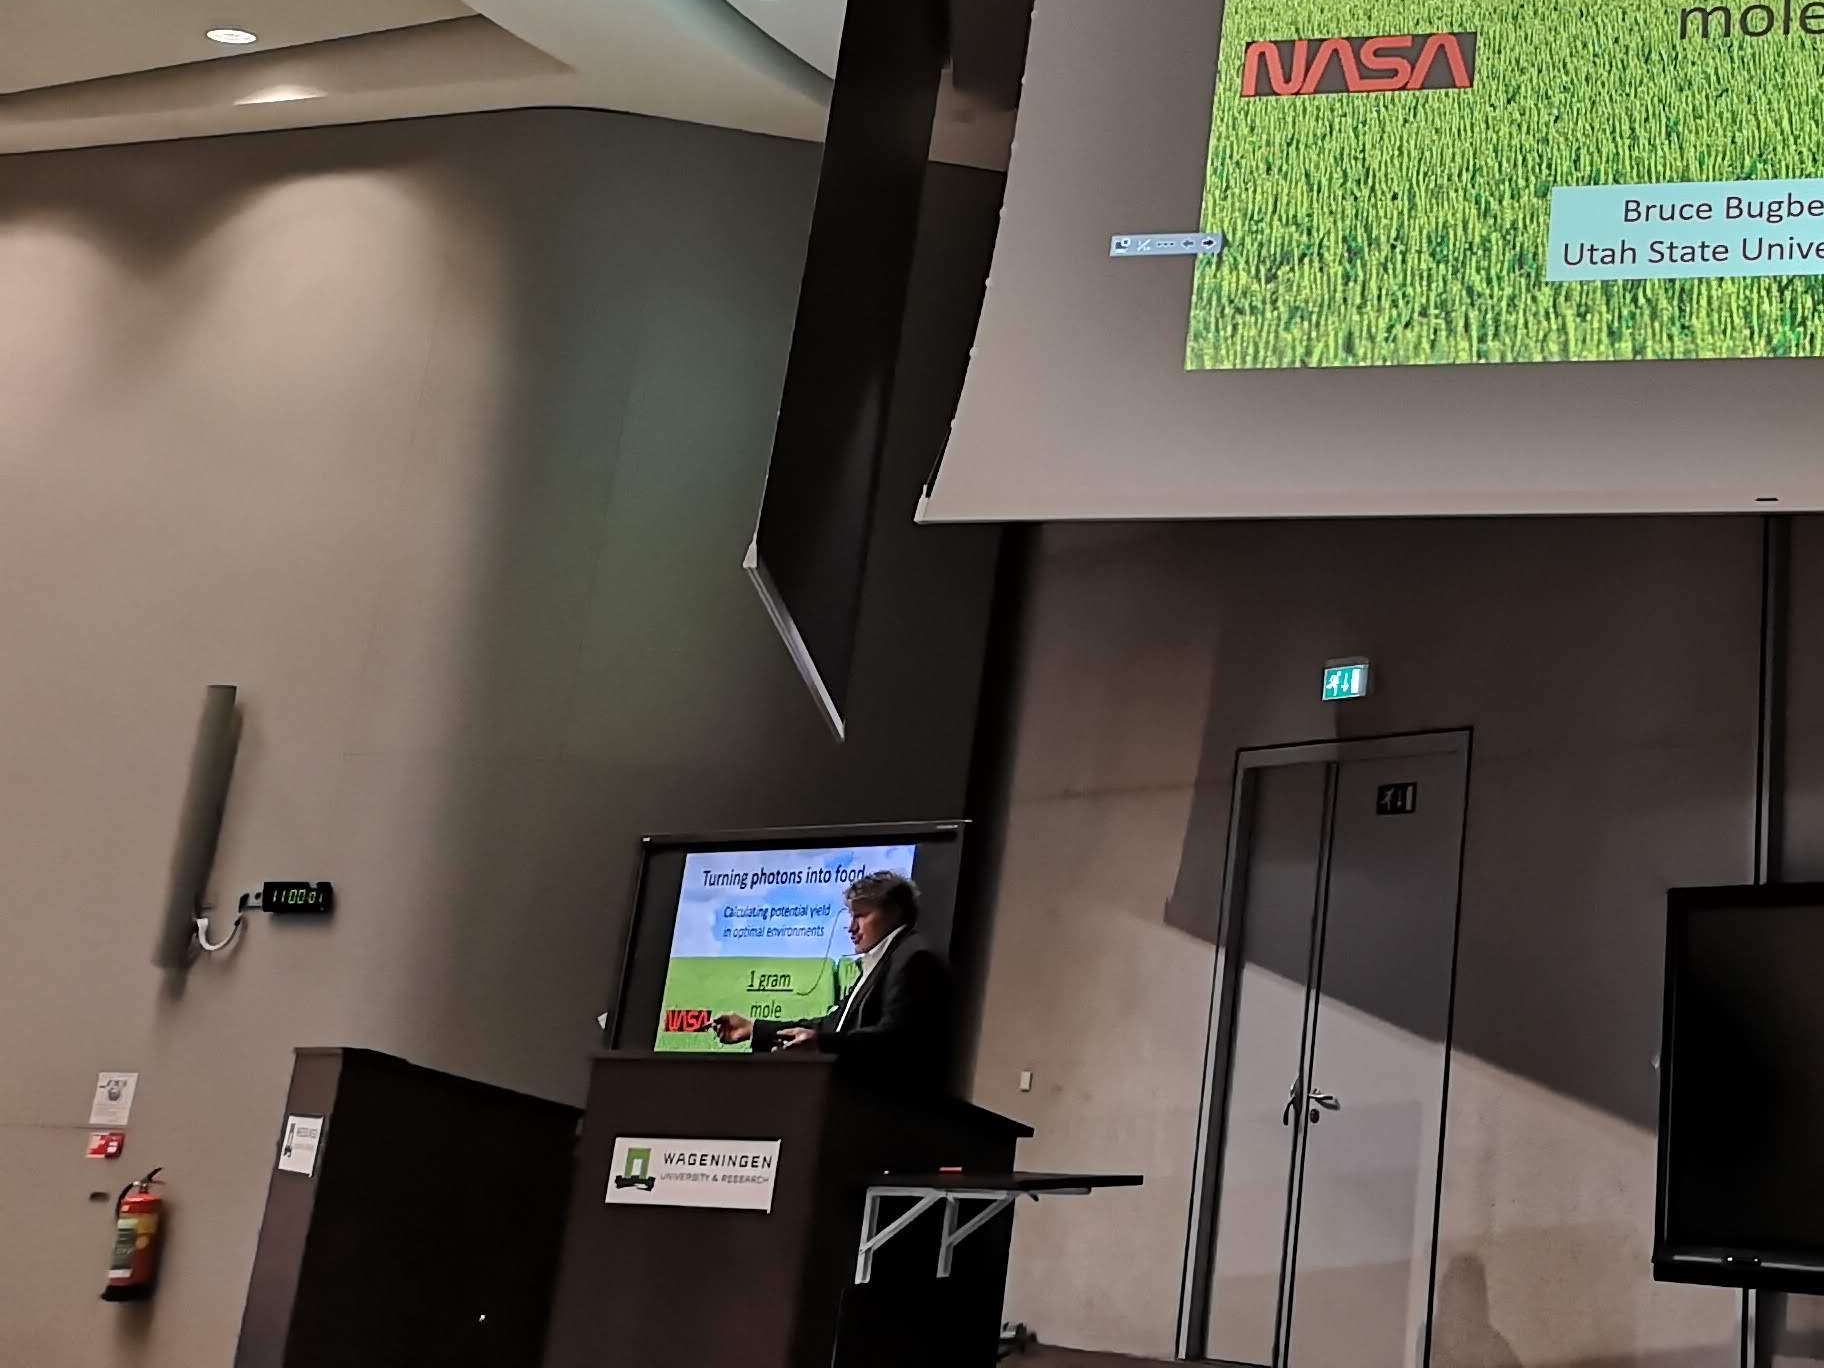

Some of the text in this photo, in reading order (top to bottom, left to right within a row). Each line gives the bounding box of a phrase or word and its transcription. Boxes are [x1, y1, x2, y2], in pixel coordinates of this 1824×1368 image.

[1241, 32, 1474, 96] NASA
[1622, 198, 1713, 224] Bruce
[1562, 238, 1638, 267] Utah
[1647, 237, 1730, 265] State
[702, 863, 867, 890] Turning photons into food
[723, 903, 832, 921] Calculating potential yield
[733, 925, 765, 939] optimal
[766, 925, 825, 938] environments
[746, 970, 792, 991] 1 gram
[750, 1000, 783, 1019] mole
[663, 1151, 773, 1169] WAGENINGEN
